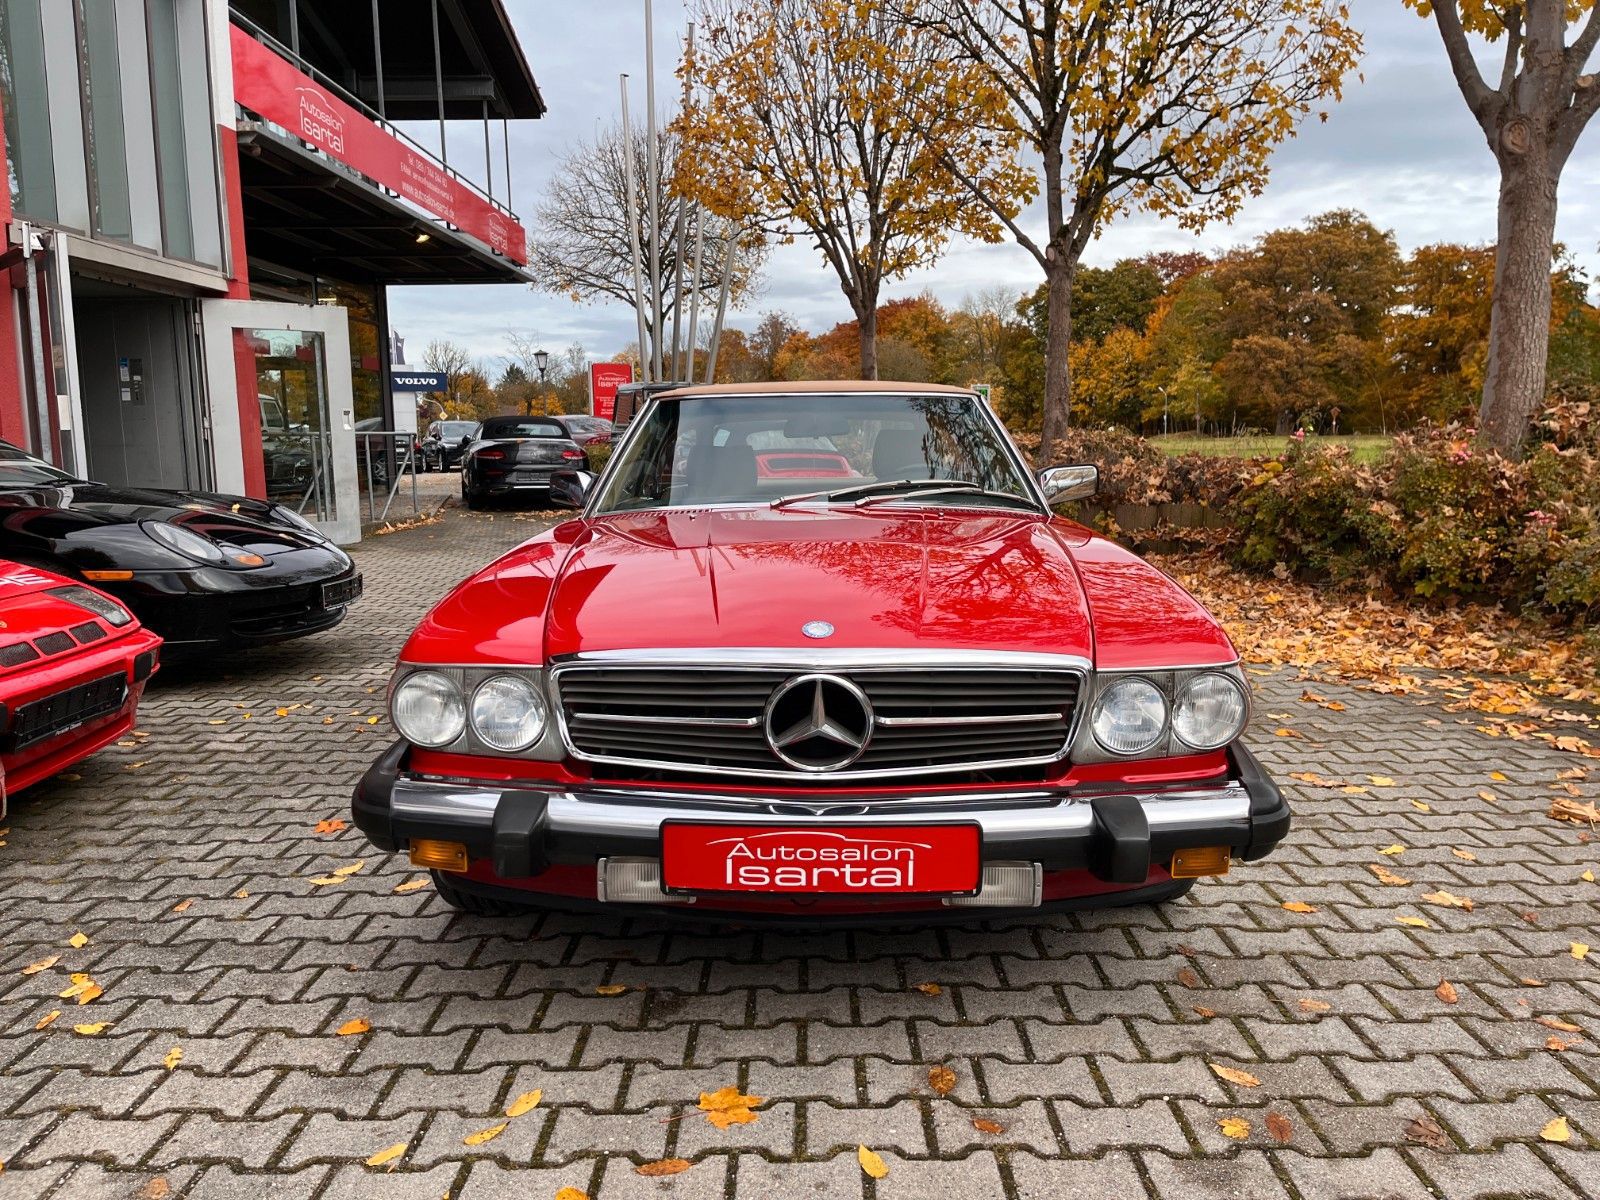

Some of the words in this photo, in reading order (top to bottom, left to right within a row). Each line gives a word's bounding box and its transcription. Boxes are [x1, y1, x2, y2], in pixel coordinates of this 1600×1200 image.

[299, 95, 343, 132] Autosalon
[299, 108, 345, 155] Isartal
[394, 377, 438, 385] VOLVO
[726, 841, 914, 862] Autosalon
[725, 858, 914, 887] Isartal
